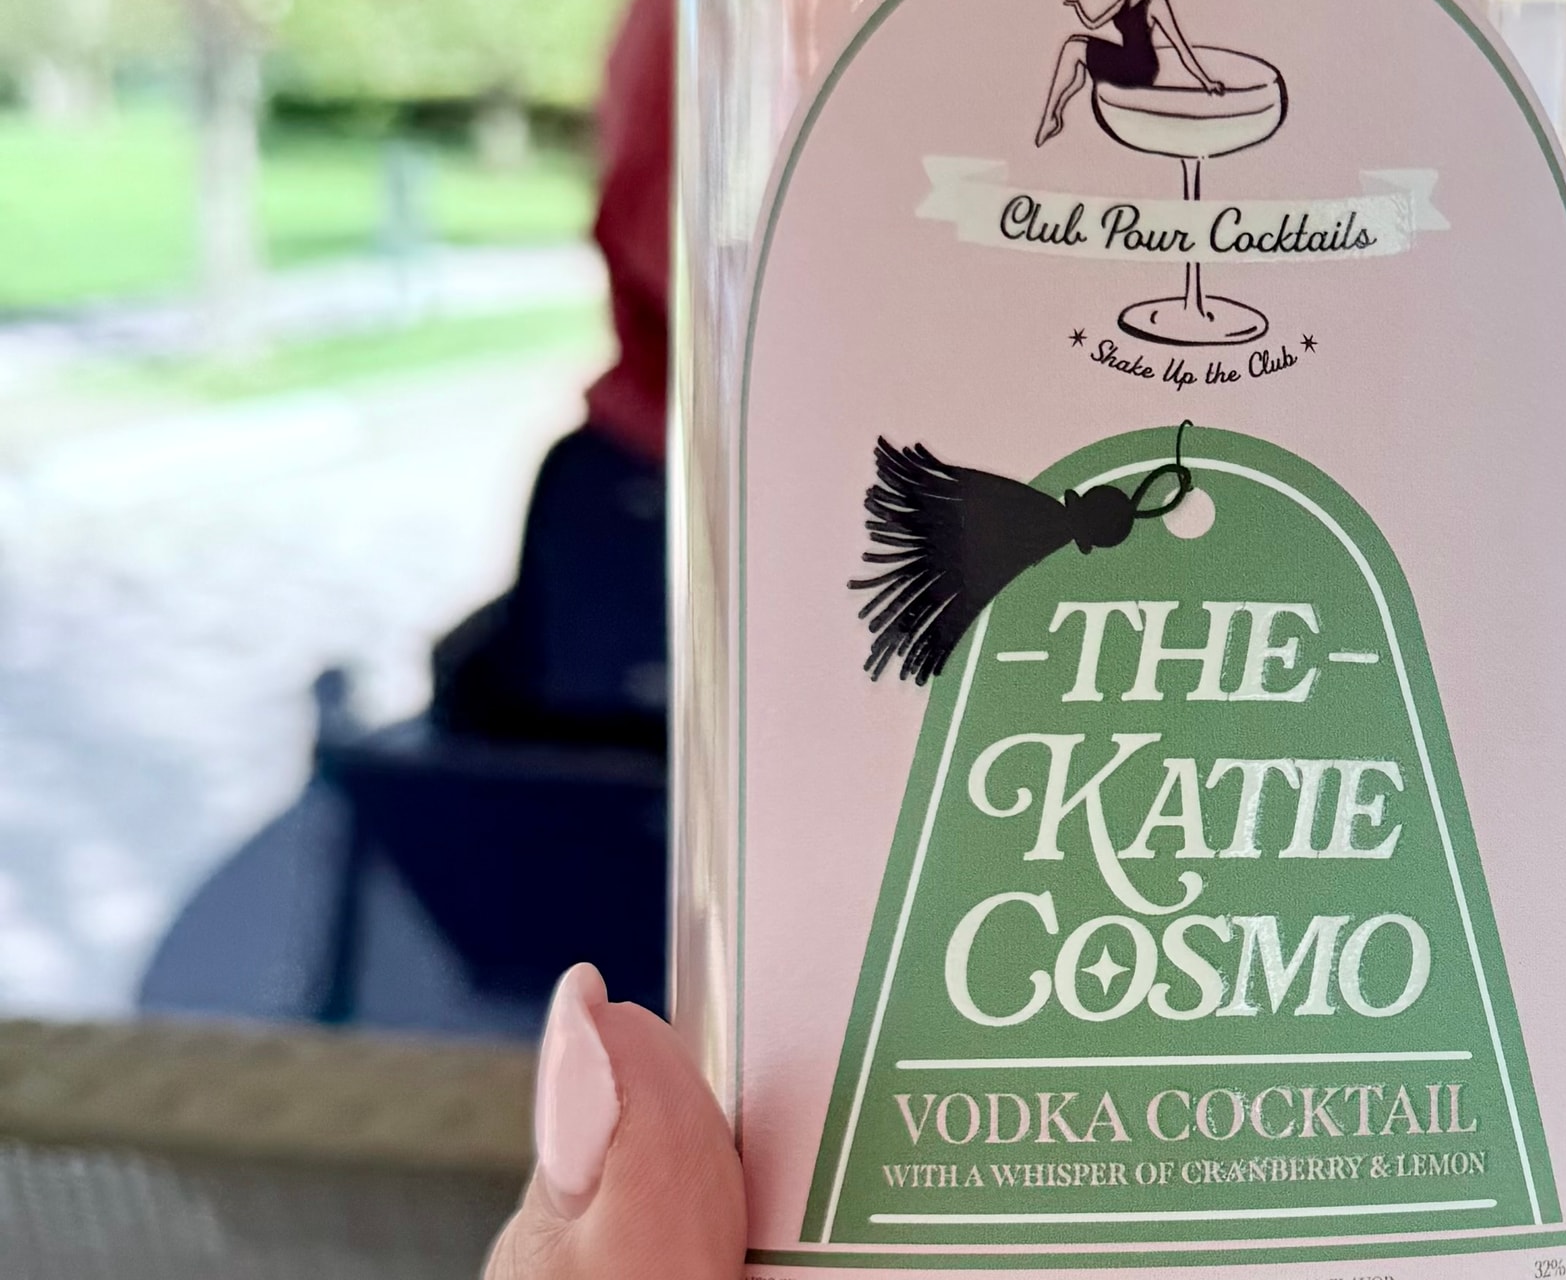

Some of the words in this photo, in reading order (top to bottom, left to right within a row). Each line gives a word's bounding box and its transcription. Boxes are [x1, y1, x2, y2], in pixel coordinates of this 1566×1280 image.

[999, 194, 1088, 244] Club
[1101, 204, 1195, 253] Pour
[1209, 207, 1377, 253] Cocktails
[1090, 339, 1155, 380] Shake
[1162, 358, 1197, 391] Up
[1205, 363, 1241, 384] the
[1248, 347, 1297, 378] Club
[1048, 600, 1320, 702] THE
[968, 732, 1405, 916] KATIE
[945, 891, 1431, 1026] COSMO
[894, 1090, 1132, 1145] VODKA
[1146, 1081, 1477, 1141] COCKTAIL
[882, 1164, 958, 1188] WITH
[962, 1164, 984, 1187] A
[991, 1162, 1126, 1188] WHISPER
[1134, 1161, 1174, 1186] OF
[1181, 1152, 1363, 1184] CRANBERRY
[1370, 1155, 1392, 1180] &
[1397, 1151, 1487, 1179] LEMON
[1534, 1258, 1566, 1279] 32%
